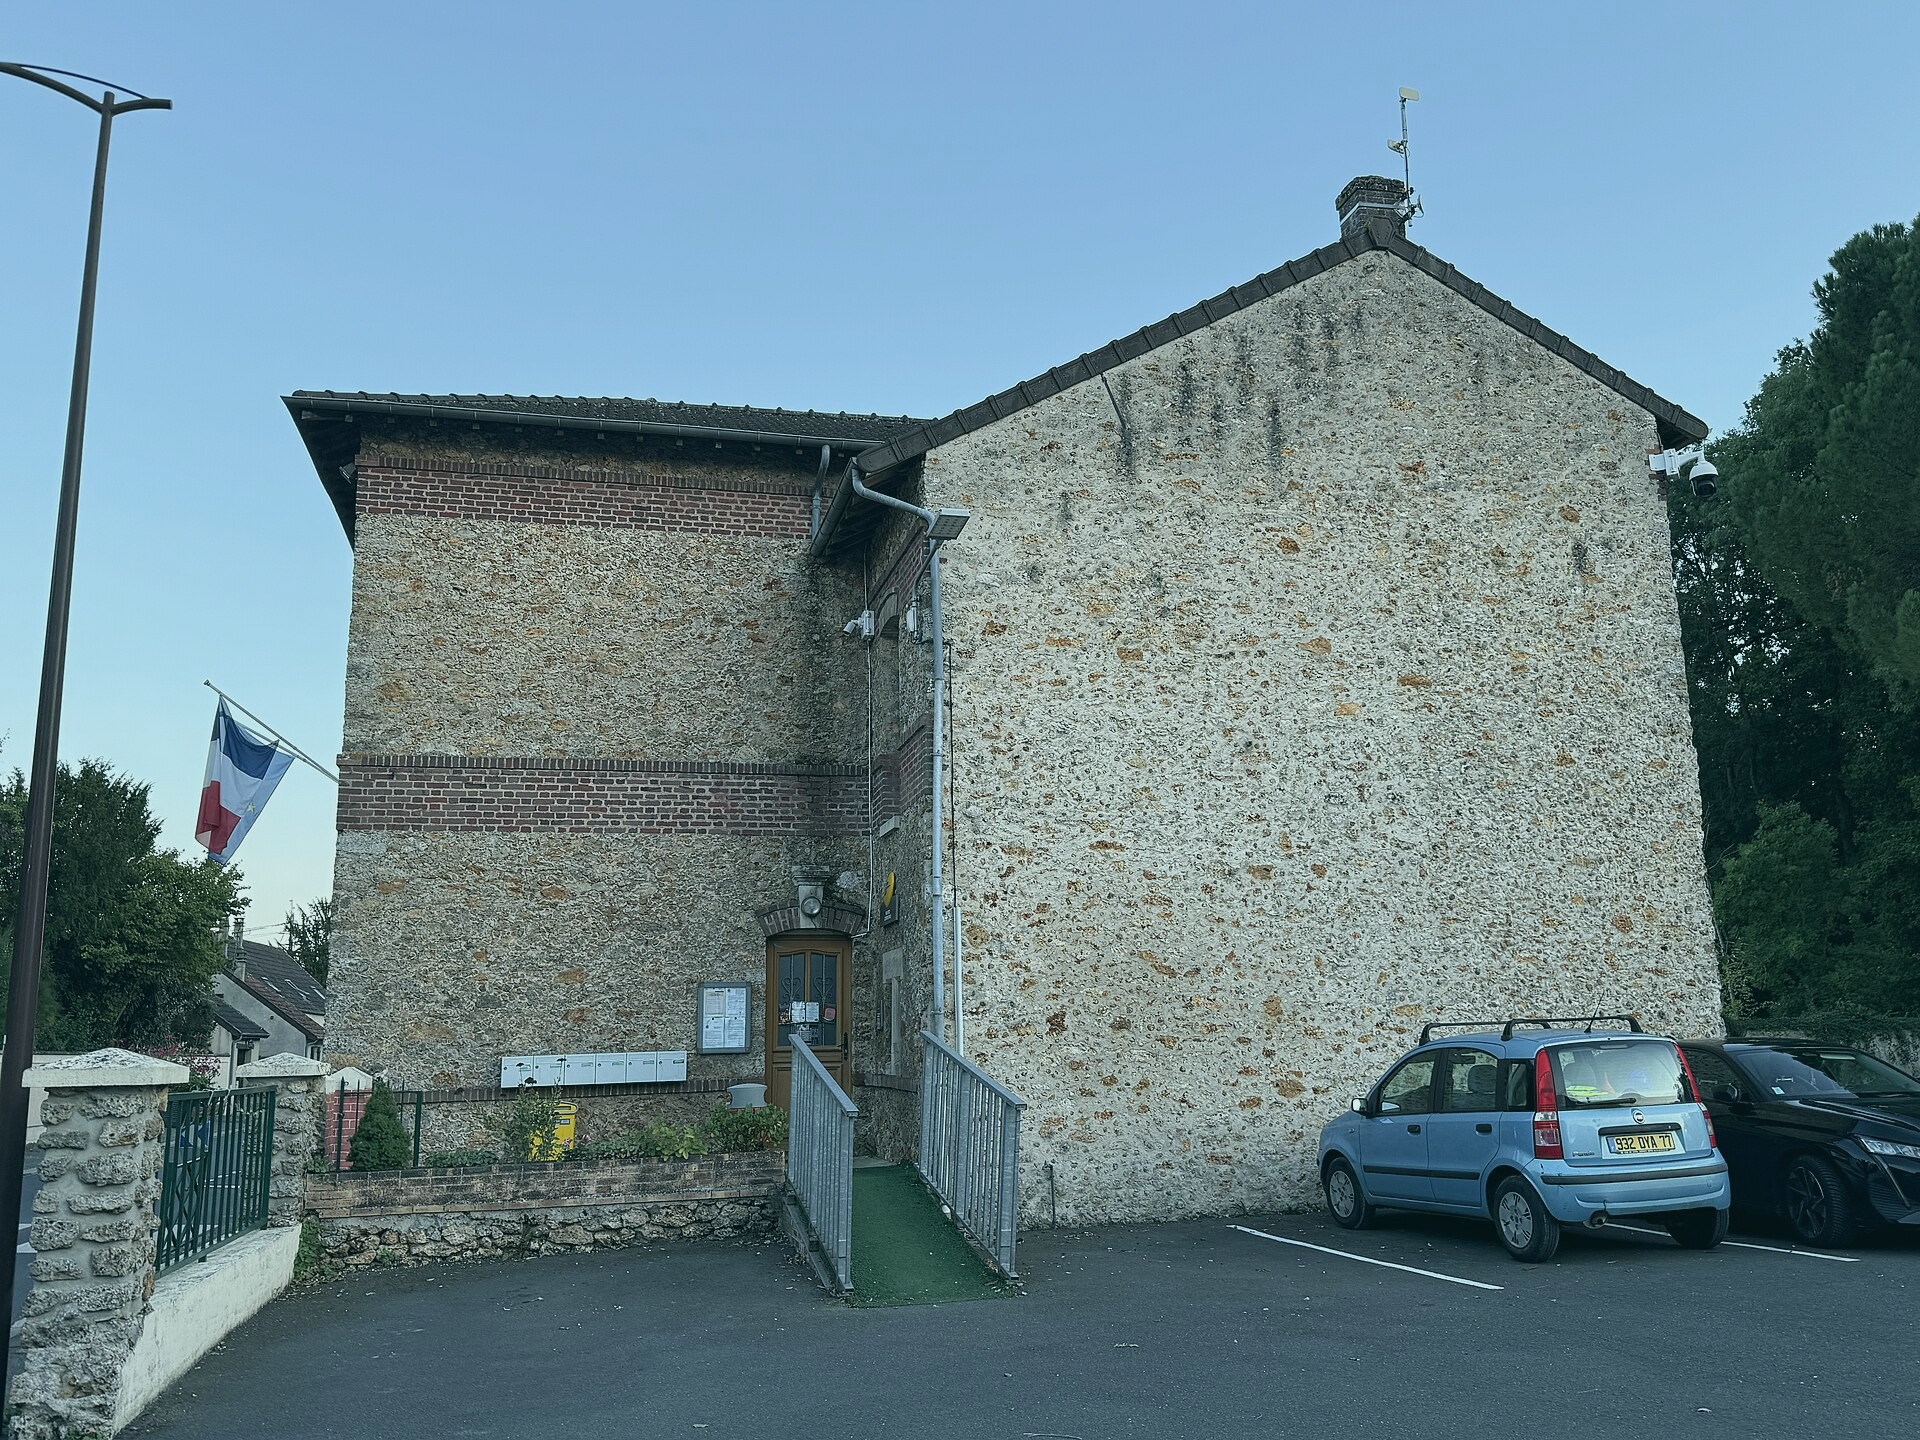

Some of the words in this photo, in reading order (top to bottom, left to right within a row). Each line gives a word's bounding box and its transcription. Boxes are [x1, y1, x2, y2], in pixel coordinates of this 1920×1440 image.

[1615, 1137, 1636, 1150] 932
[1638, 1136, 1657, 1149] DYA
[1659, 1135, 1672, 1148] 77
